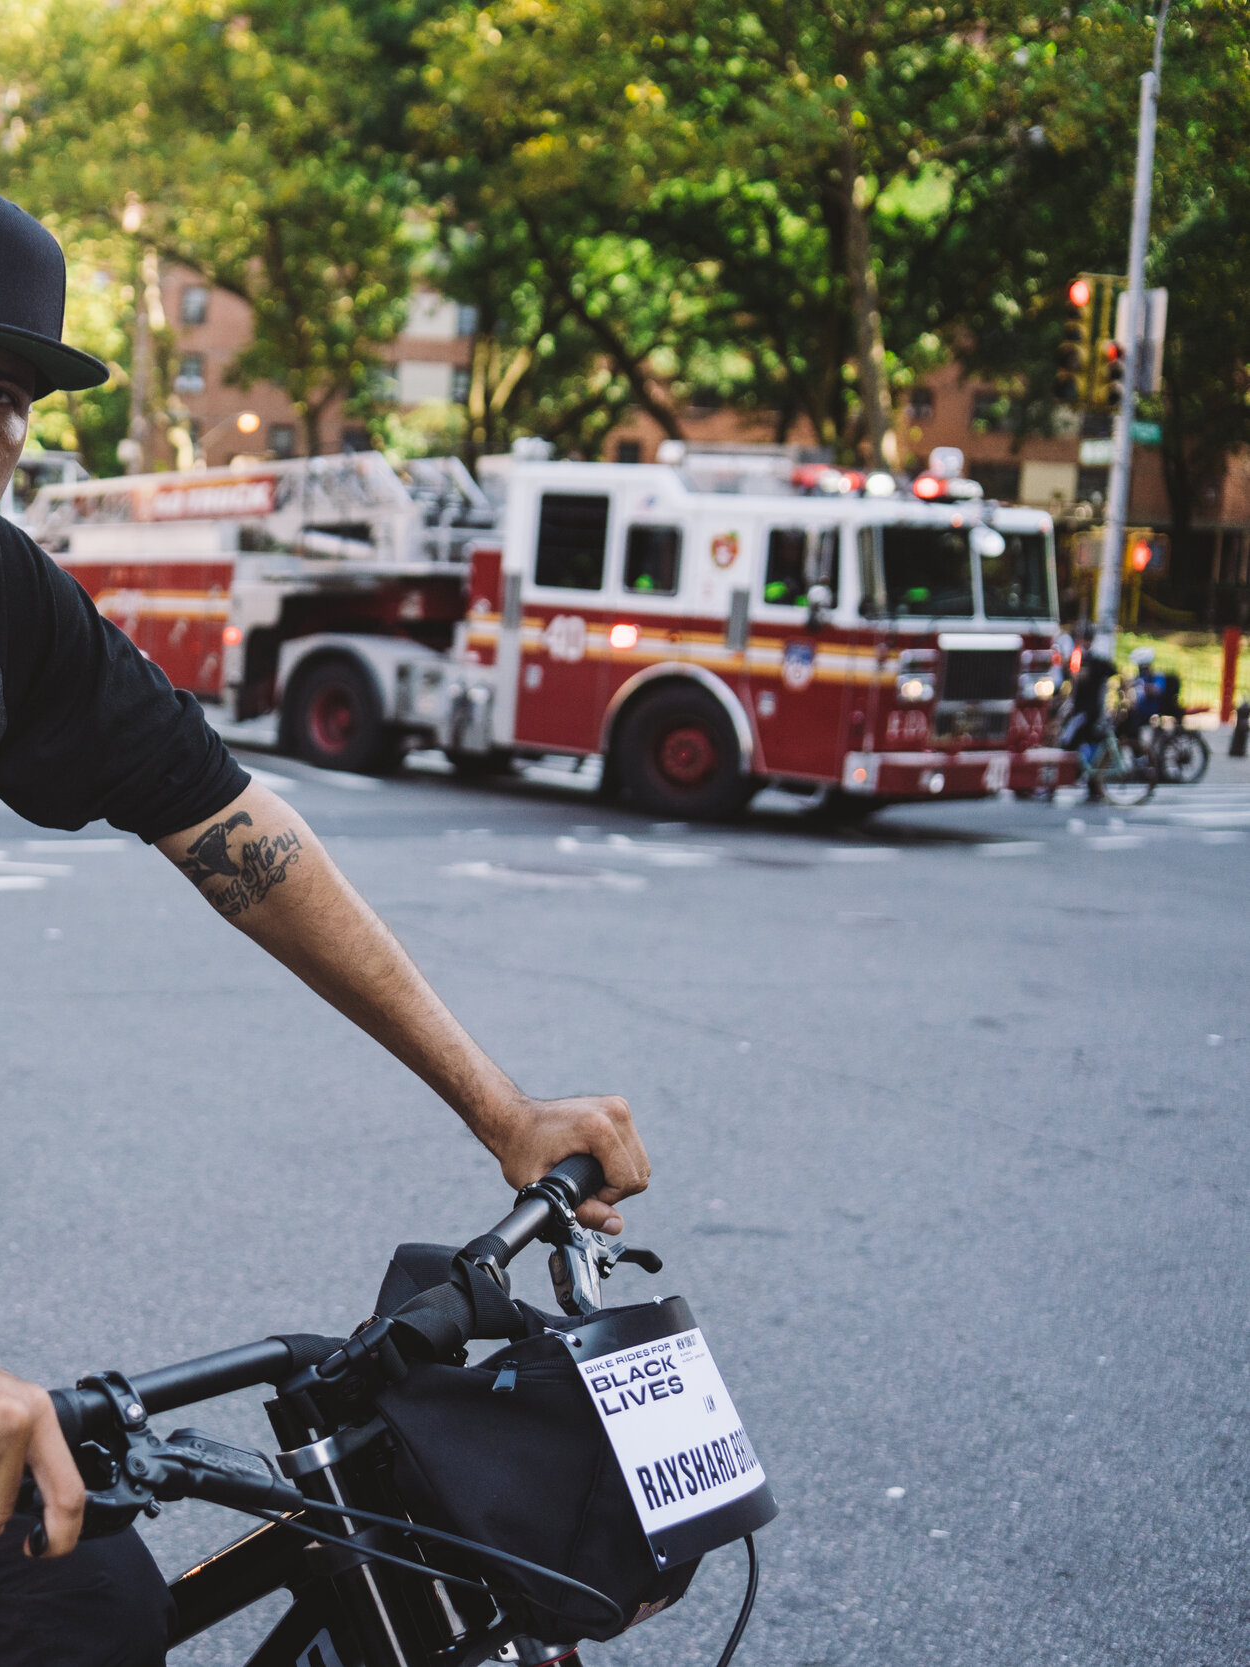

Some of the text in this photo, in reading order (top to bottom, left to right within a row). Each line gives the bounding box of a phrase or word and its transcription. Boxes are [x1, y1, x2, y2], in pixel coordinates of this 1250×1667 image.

[584, 1342, 672, 1375] BIKE RIDES FOR
[590, 1354, 677, 1394] BLACK
[598, 1374, 685, 1417] LIVES
[635, 1436, 738, 1511] RAYSHARD
